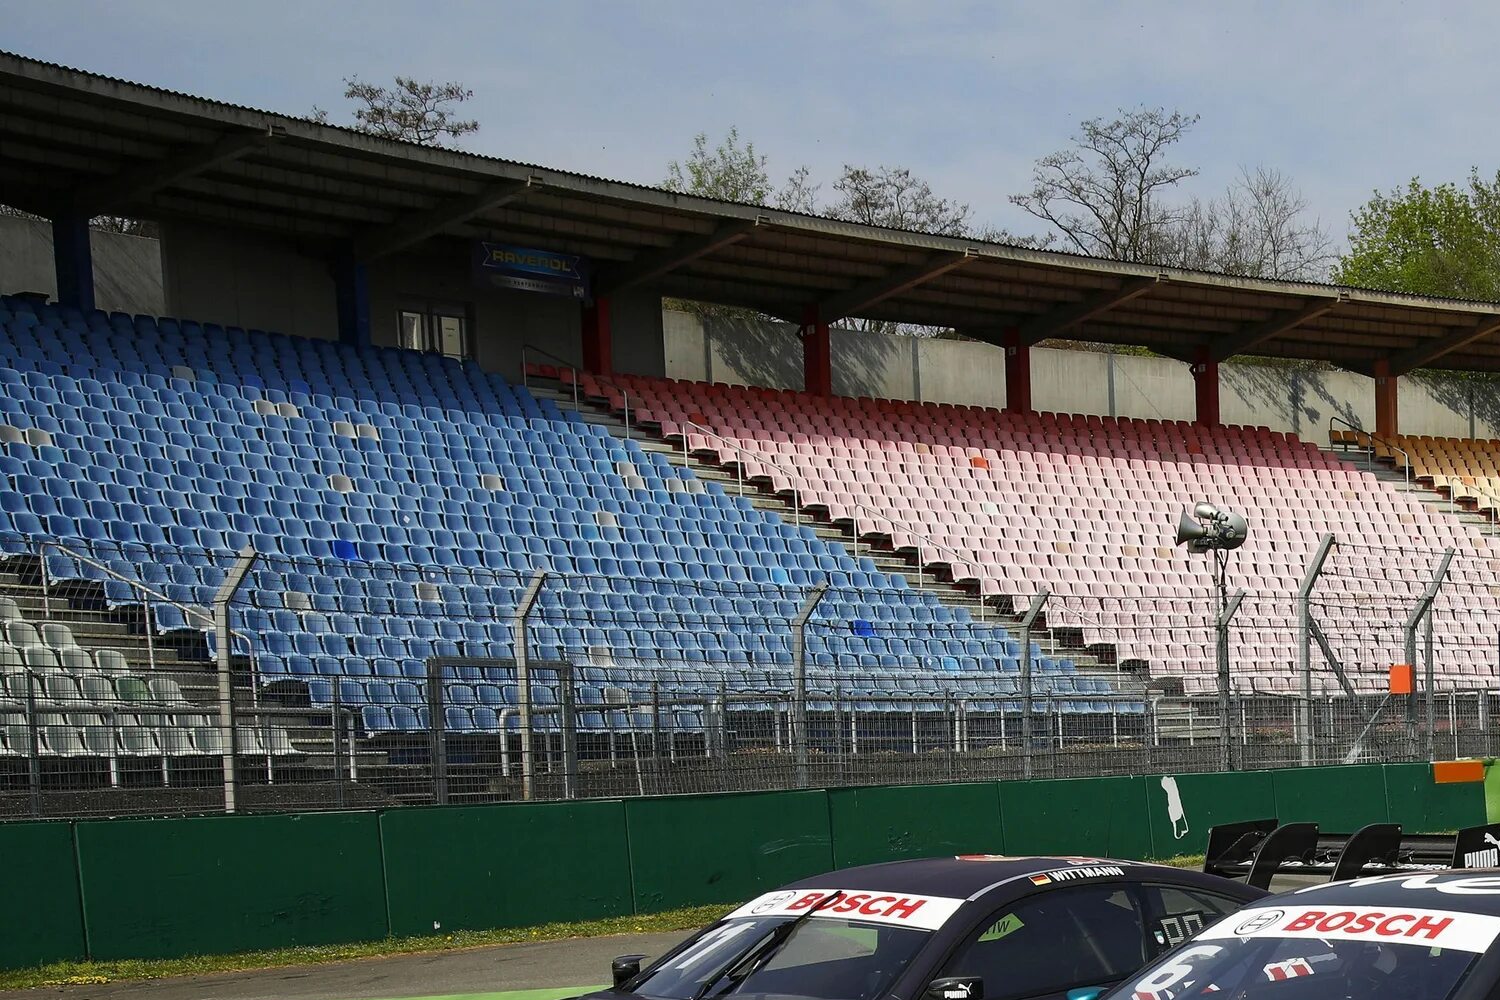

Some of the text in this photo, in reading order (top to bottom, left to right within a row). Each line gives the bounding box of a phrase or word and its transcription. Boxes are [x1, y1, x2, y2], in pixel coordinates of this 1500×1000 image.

[492, 249, 572, 272] RAVENOL
[1464, 848, 1499, 868] PUMA
[1049, 866, 1125, 882] WITTMANN
[785, 892, 928, 919] BOSCH
[1282, 911, 1455, 939] BOSCH
[1134, 944, 1224, 993] 6
[944, 990, 968, 999] PUMA
